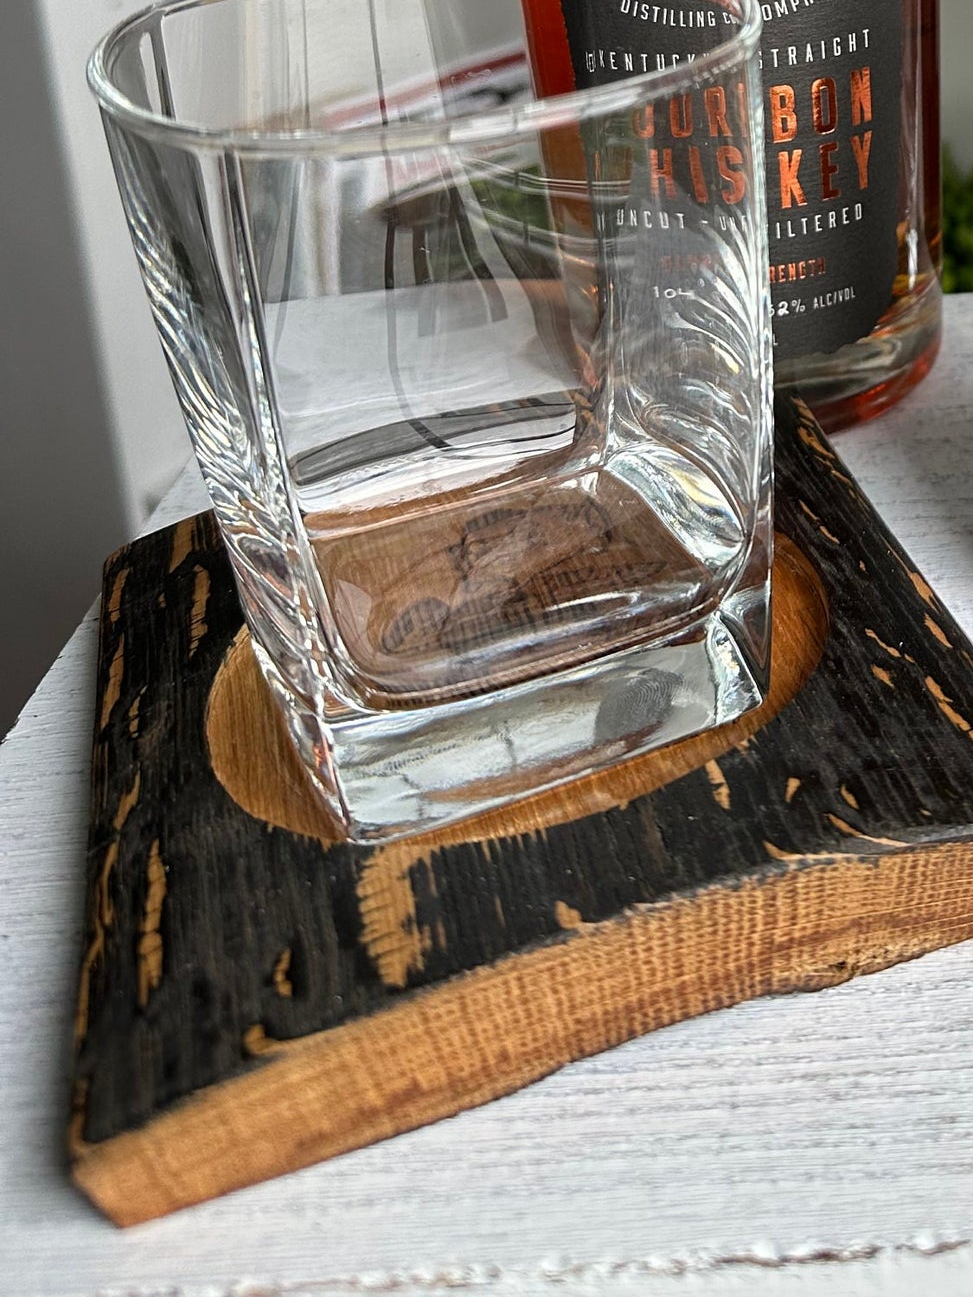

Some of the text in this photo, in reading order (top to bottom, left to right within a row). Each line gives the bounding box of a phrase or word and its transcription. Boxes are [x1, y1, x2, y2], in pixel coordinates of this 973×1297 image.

[631, 66, 874, 144] OURBON
[650, 131, 874, 209] HISKEY
[616, 209, 686, 230] UNCUT
[769, 256, 826, 284] RENGTH
[813, 286, 857, 310] ALC/VOL
